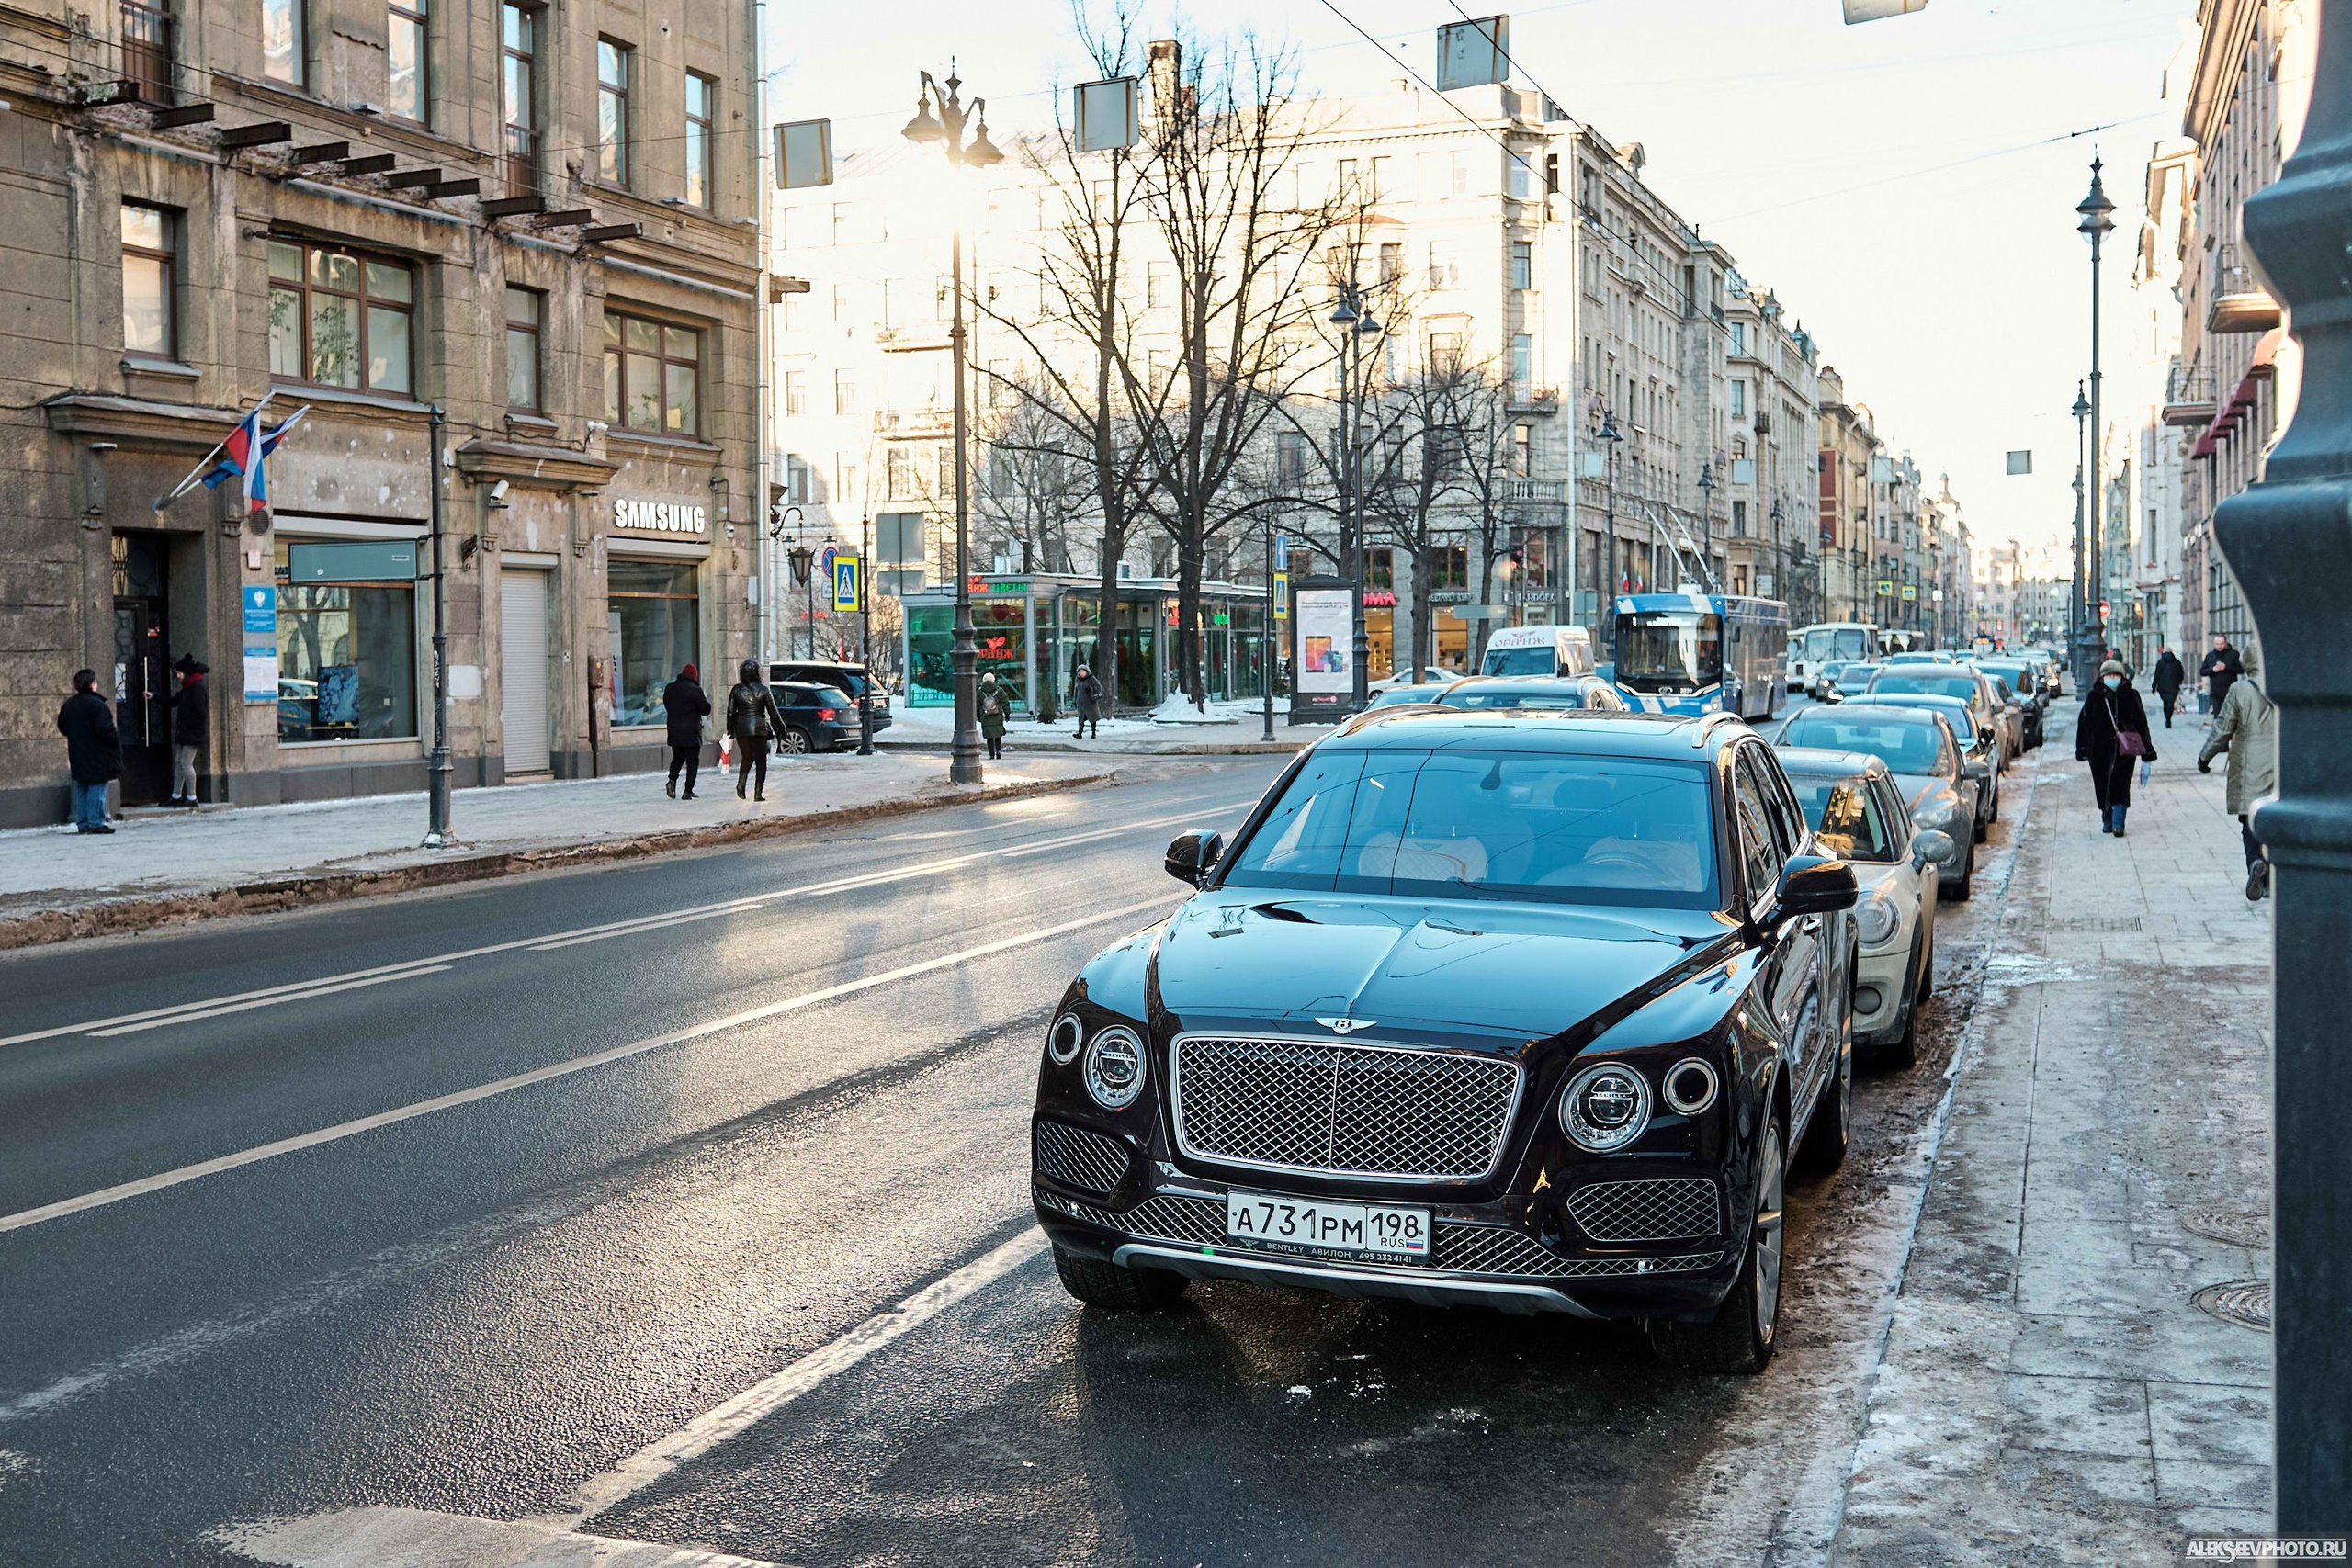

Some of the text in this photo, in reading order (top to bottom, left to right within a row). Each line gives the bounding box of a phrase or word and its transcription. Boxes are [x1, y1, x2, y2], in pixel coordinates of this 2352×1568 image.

[615, 499, 705, 533] SAMSUNG
[992, 582, 1026, 593] ЦВЕТЫ
[1495, 637, 1545, 648] ОРАНЖ
[1237, 1202, 1419, 1244] А731РМ 198
[1380, 1237, 1405, 1248] RUS
[1266, 1242, 1305, 1253] BENTLEY
[1311, 1247, 1351, 1258] АВИЛОН
[1359, 1252, 1374, 1260] 495
